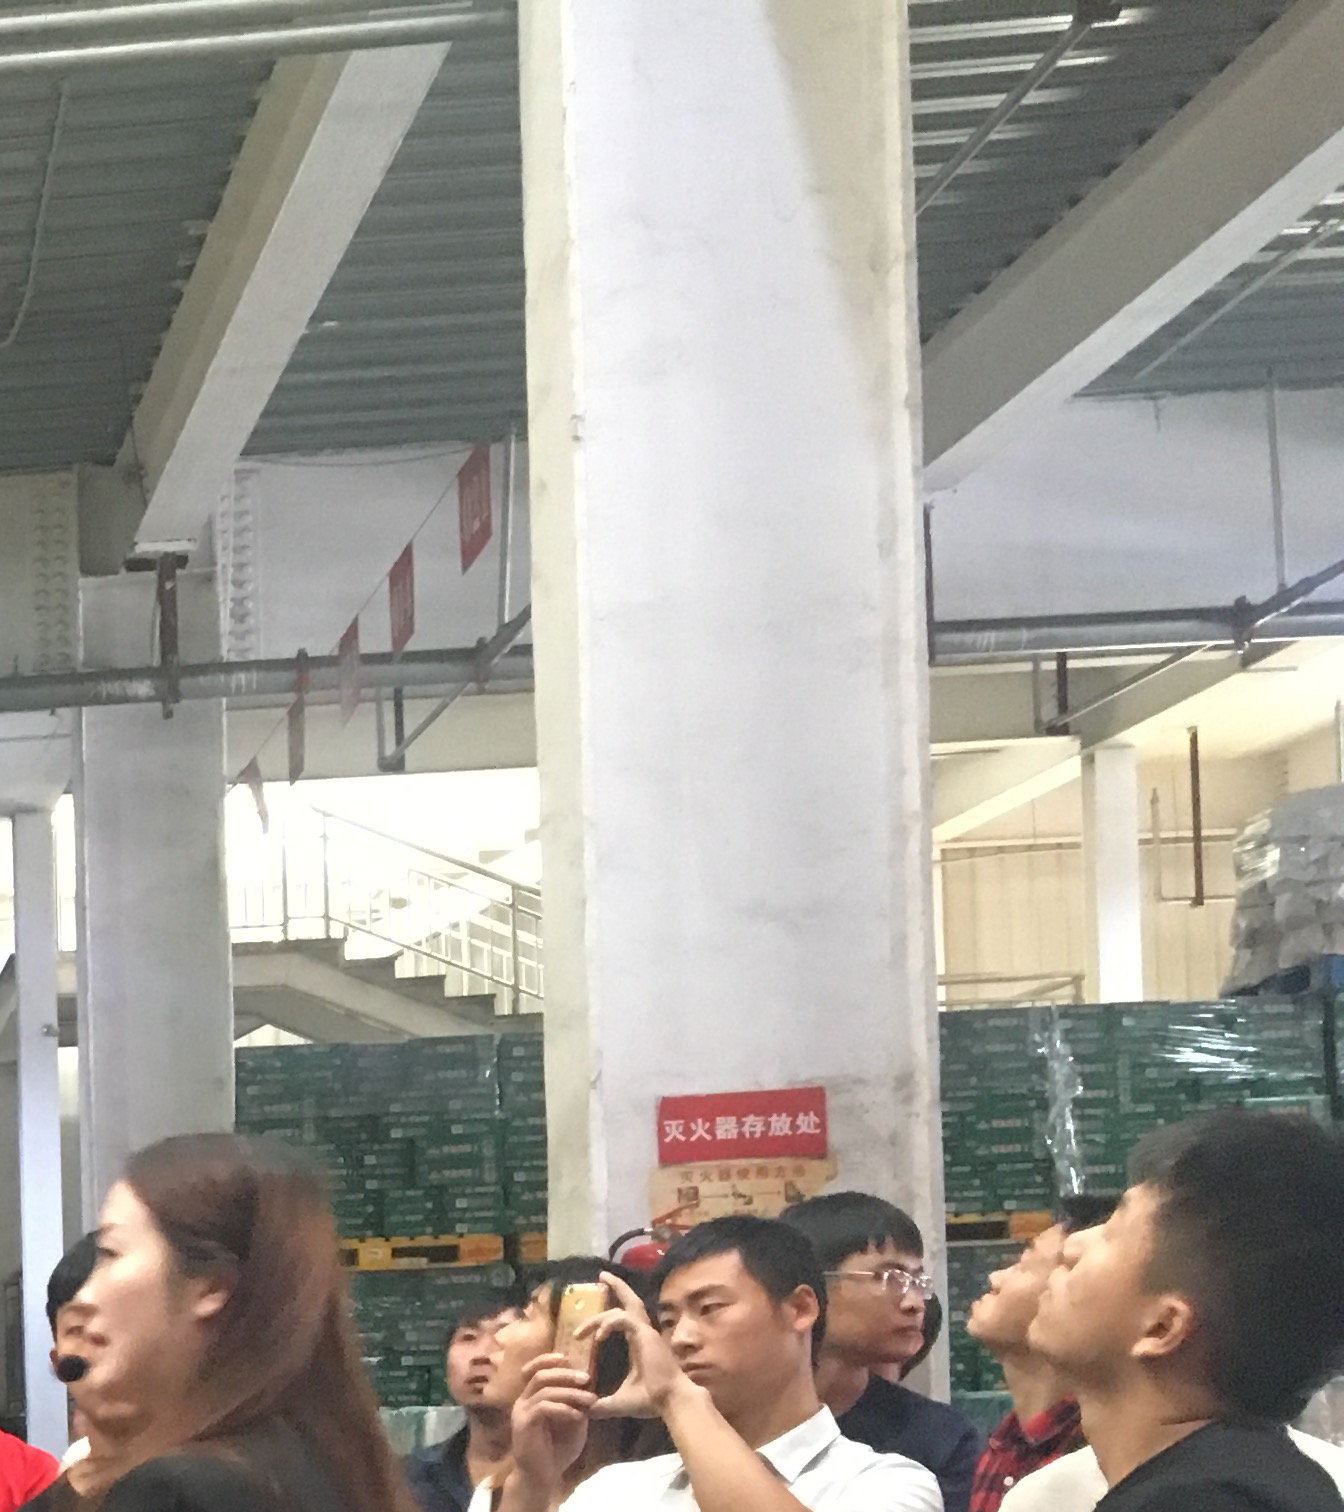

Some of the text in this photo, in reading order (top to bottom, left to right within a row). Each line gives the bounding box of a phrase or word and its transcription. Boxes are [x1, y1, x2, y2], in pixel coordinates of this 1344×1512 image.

[663, 1111, 821, 1143] 灭火器存放处
